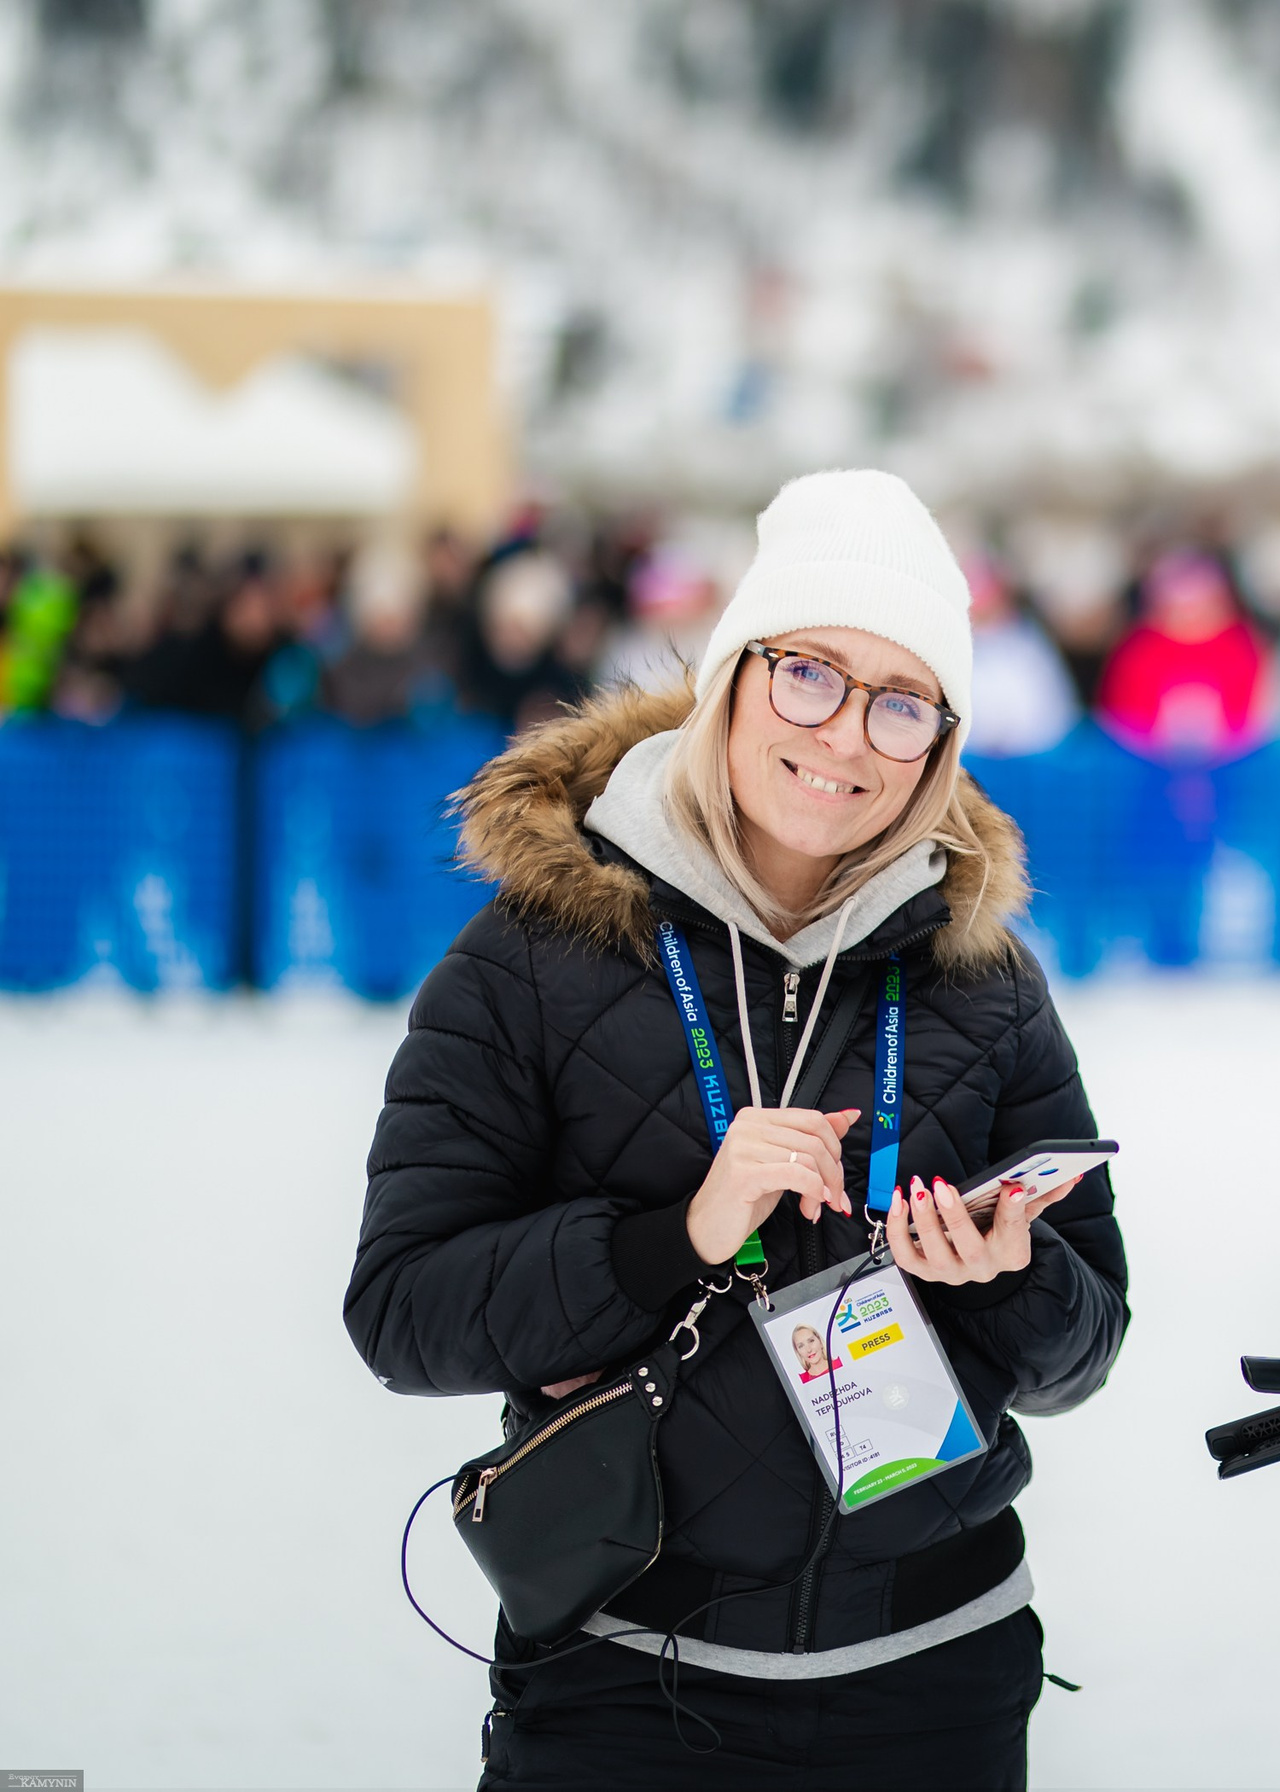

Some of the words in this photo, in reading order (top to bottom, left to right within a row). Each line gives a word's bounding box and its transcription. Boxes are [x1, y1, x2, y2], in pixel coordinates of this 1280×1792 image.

[885, 1006, 899, 1033] Asia
[680, 992, 698, 1022] Asia
[691, 1028, 714, 1069] 2023
[883, 1049, 897, 1104] Children
[859, 1296, 889, 1317] 2023
[863, 1307, 893, 1323] KUZBASS
[861, 1333, 891, 1351] PRESS
[854, 1482, 877, 1495] FEBRUARY
